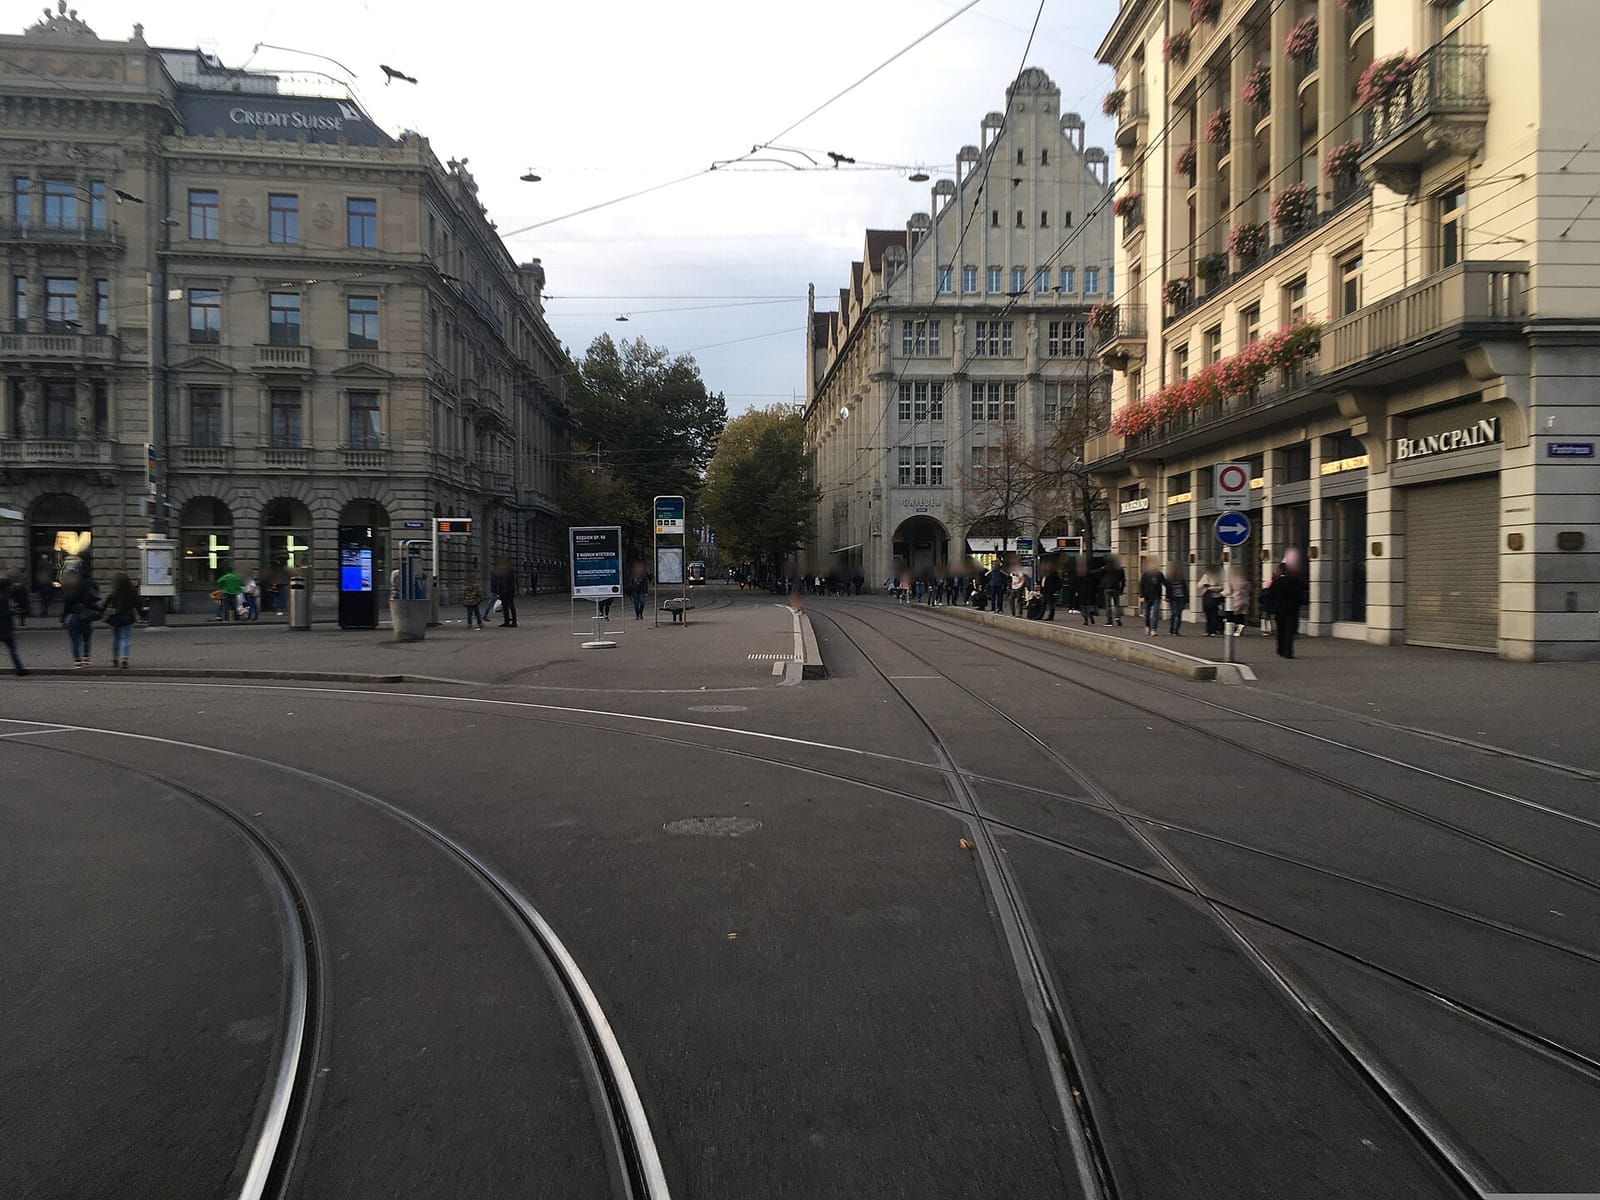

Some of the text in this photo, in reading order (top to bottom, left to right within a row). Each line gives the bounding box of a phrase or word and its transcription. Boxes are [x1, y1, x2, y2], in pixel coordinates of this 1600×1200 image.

[229, 107, 344, 131] CREDIT SUISSE
[1396, 417, 1497, 460] BLANCPAIN
